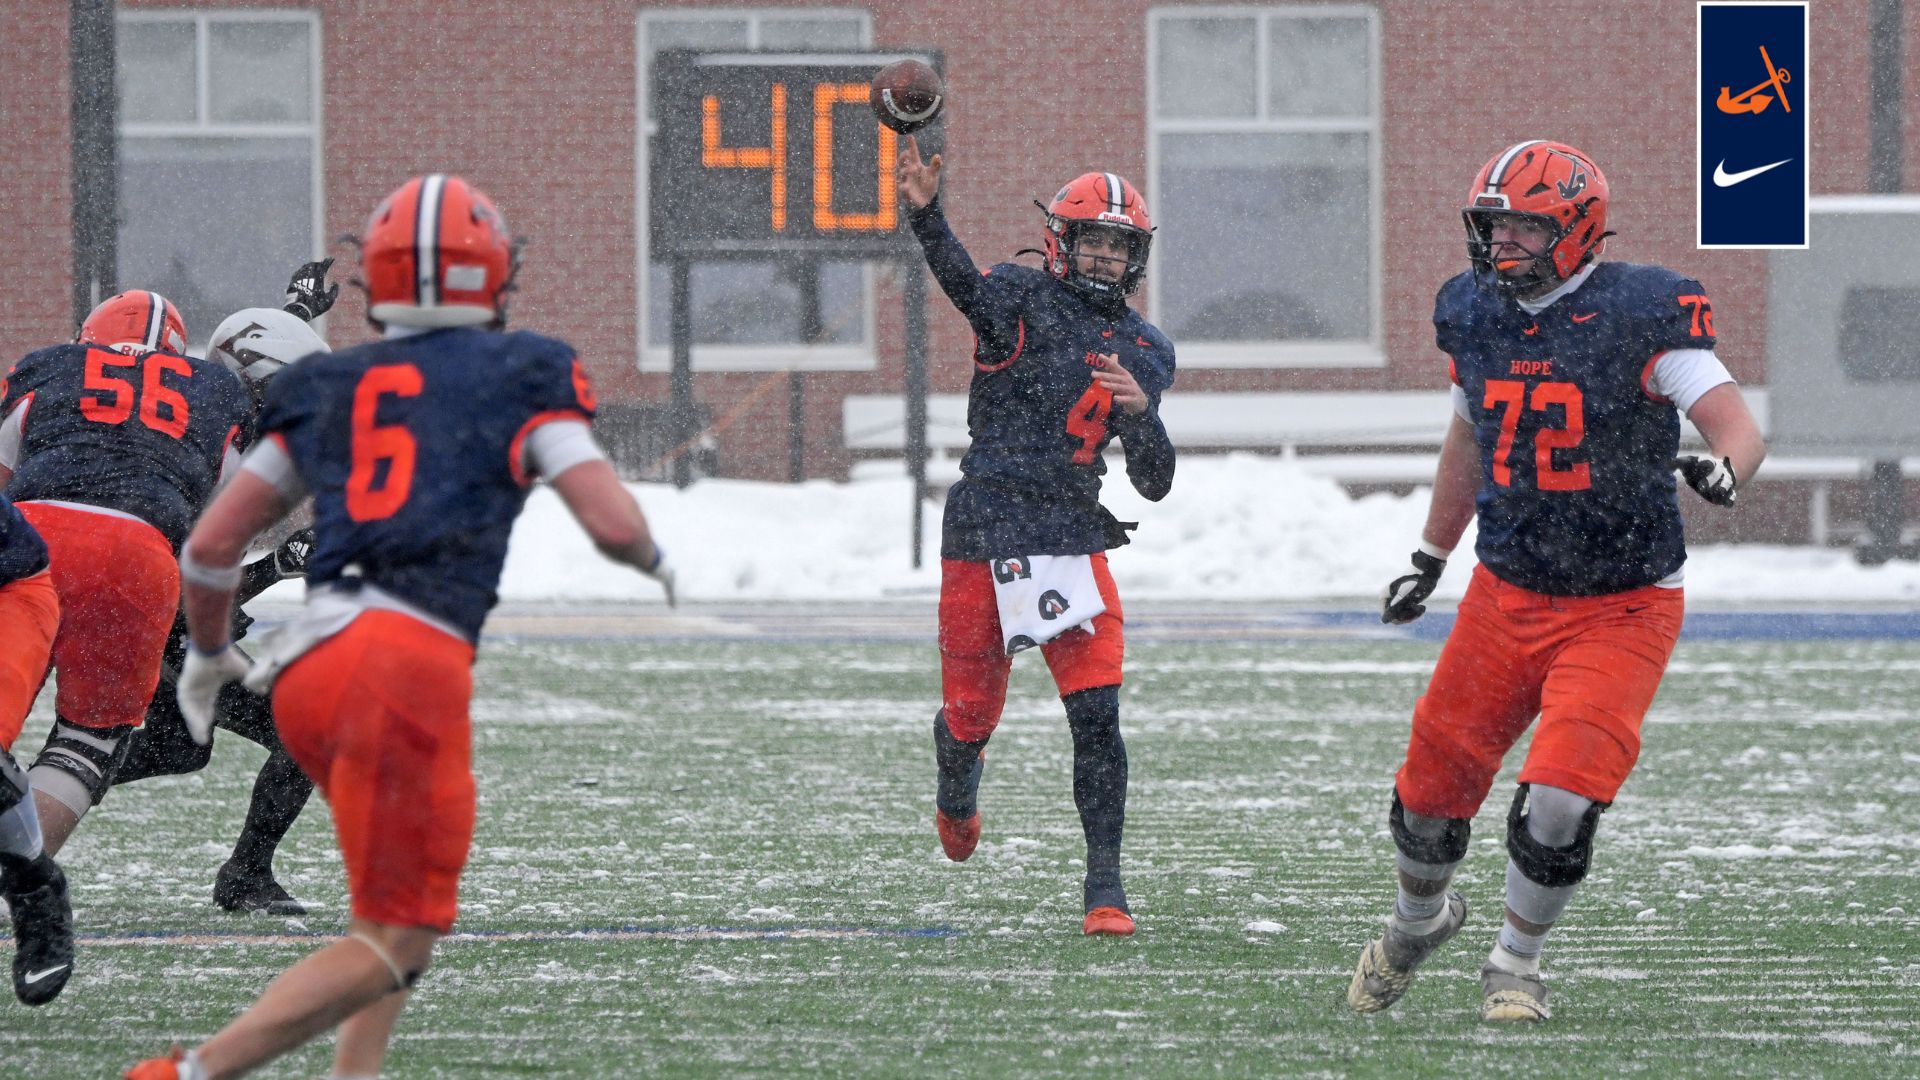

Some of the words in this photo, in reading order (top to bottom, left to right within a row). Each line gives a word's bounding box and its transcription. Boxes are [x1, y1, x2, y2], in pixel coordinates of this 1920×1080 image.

[703, 83, 897, 231] 40
[80, 347, 193, 439] 56
[1510, 360, 1552, 375] HOPE
[346, 363, 424, 522] 6
[1066, 379, 1113, 464] 4
[1483, 379, 1591, 491] 72
